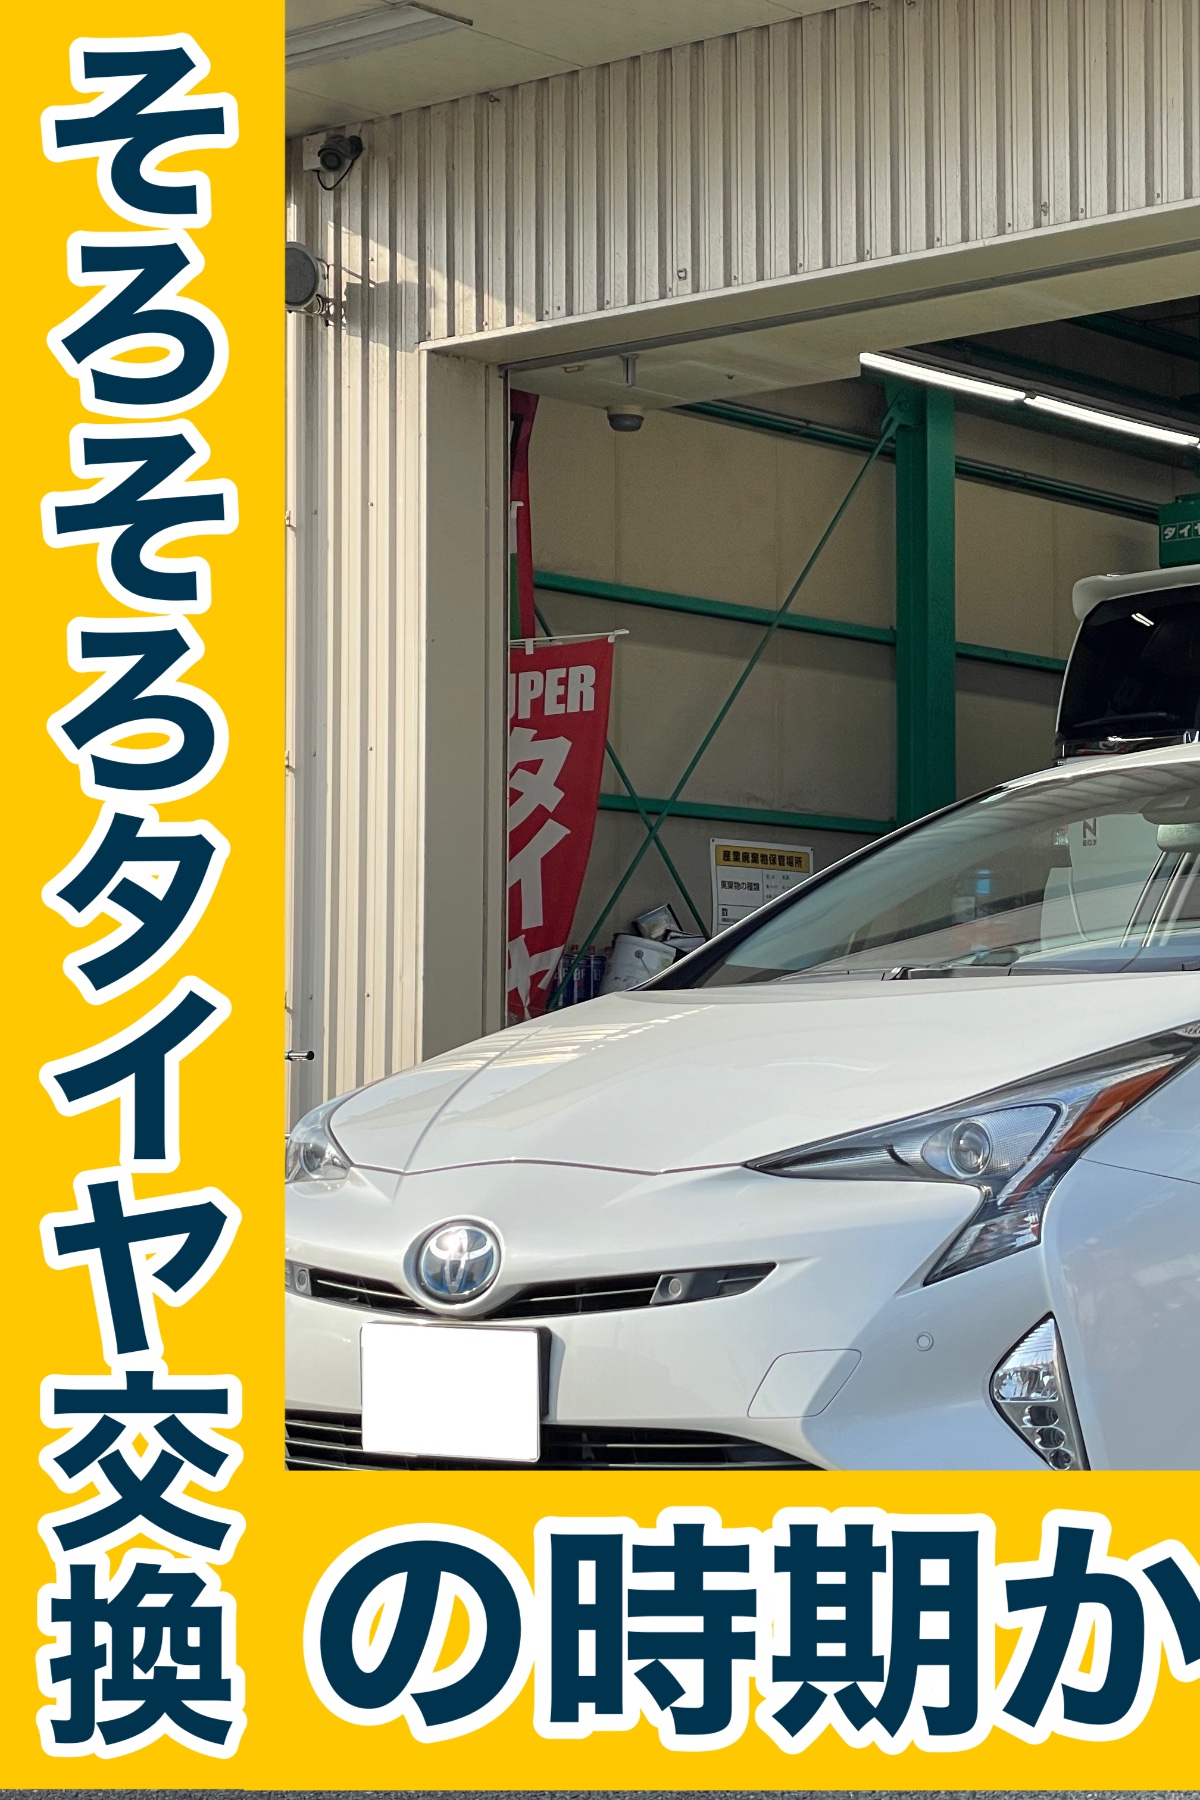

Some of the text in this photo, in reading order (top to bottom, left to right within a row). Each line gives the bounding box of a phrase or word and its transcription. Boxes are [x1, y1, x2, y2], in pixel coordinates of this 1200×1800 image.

[722, 850, 803, 868] 産業廃棄物保管場所
